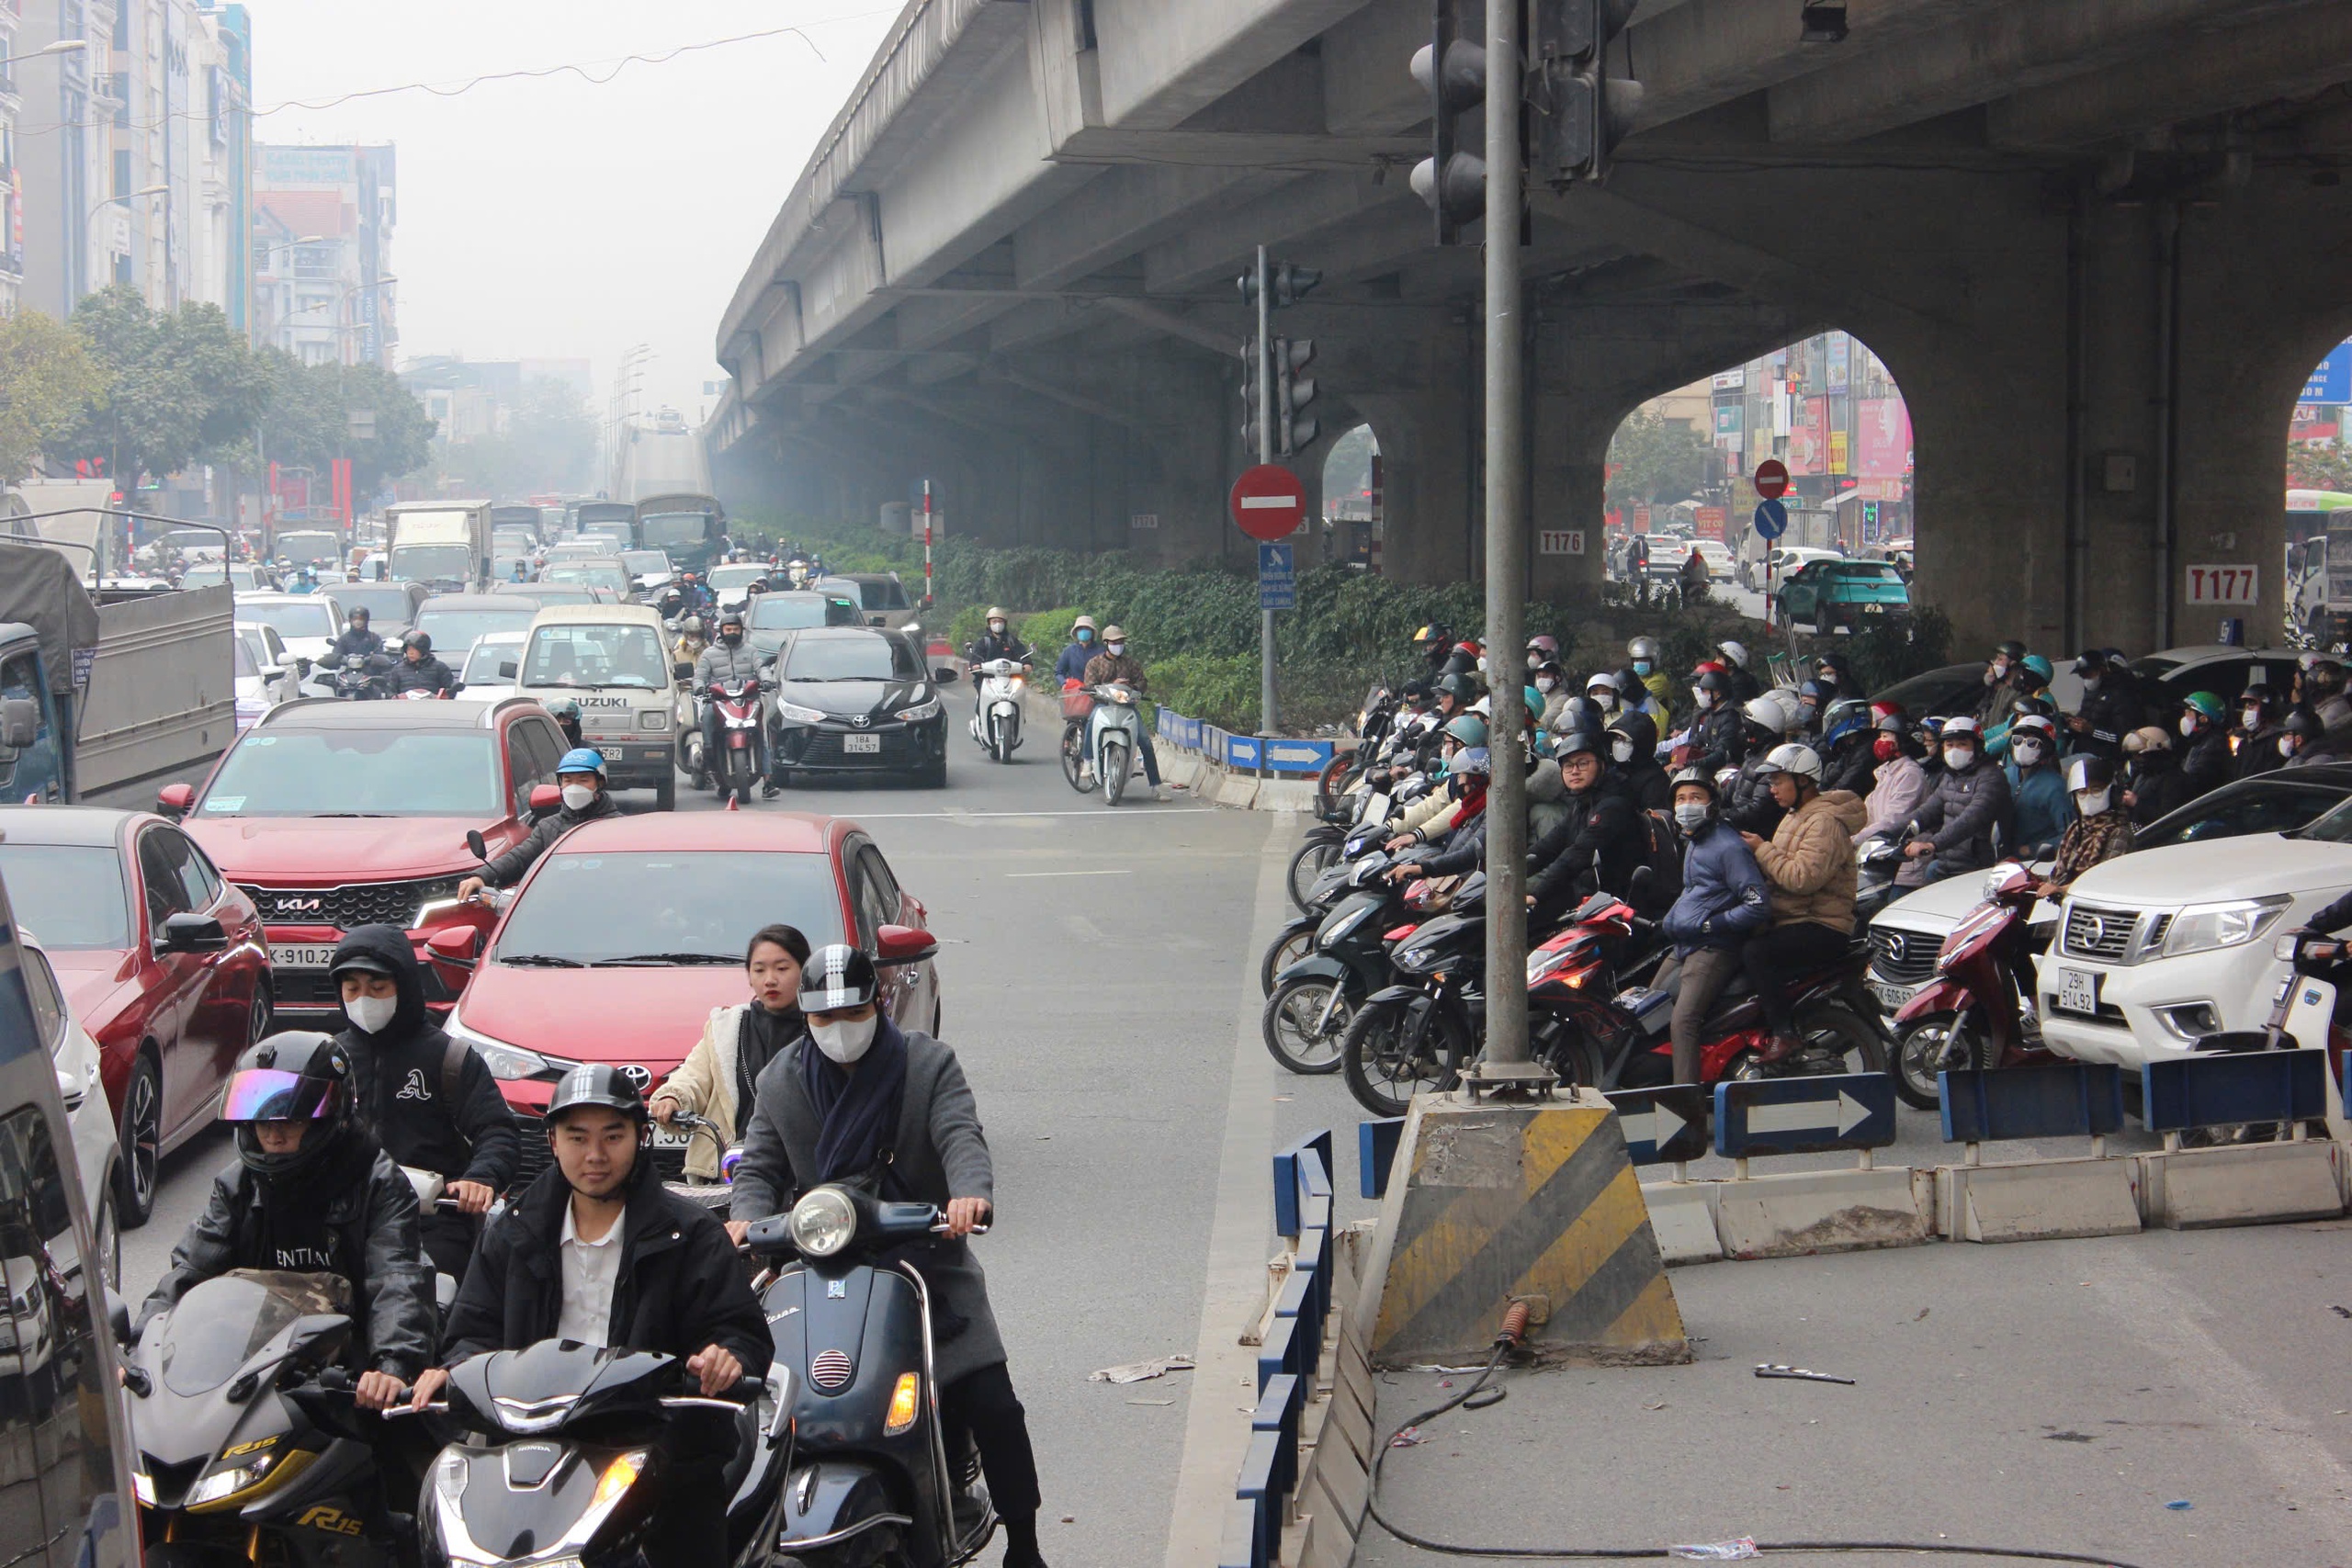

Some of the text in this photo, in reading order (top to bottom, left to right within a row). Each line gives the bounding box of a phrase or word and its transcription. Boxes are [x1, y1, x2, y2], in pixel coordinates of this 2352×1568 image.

[1544, 533, 1580, 551] T176
[2192, 570, 2253, 599] T177
[570, 697, 627, 707] UZUKI
[277, 898, 320, 910] KIA
[2068, 972, 2084, 991] 29H
[2063, 990, 2092, 1010] 514.92
